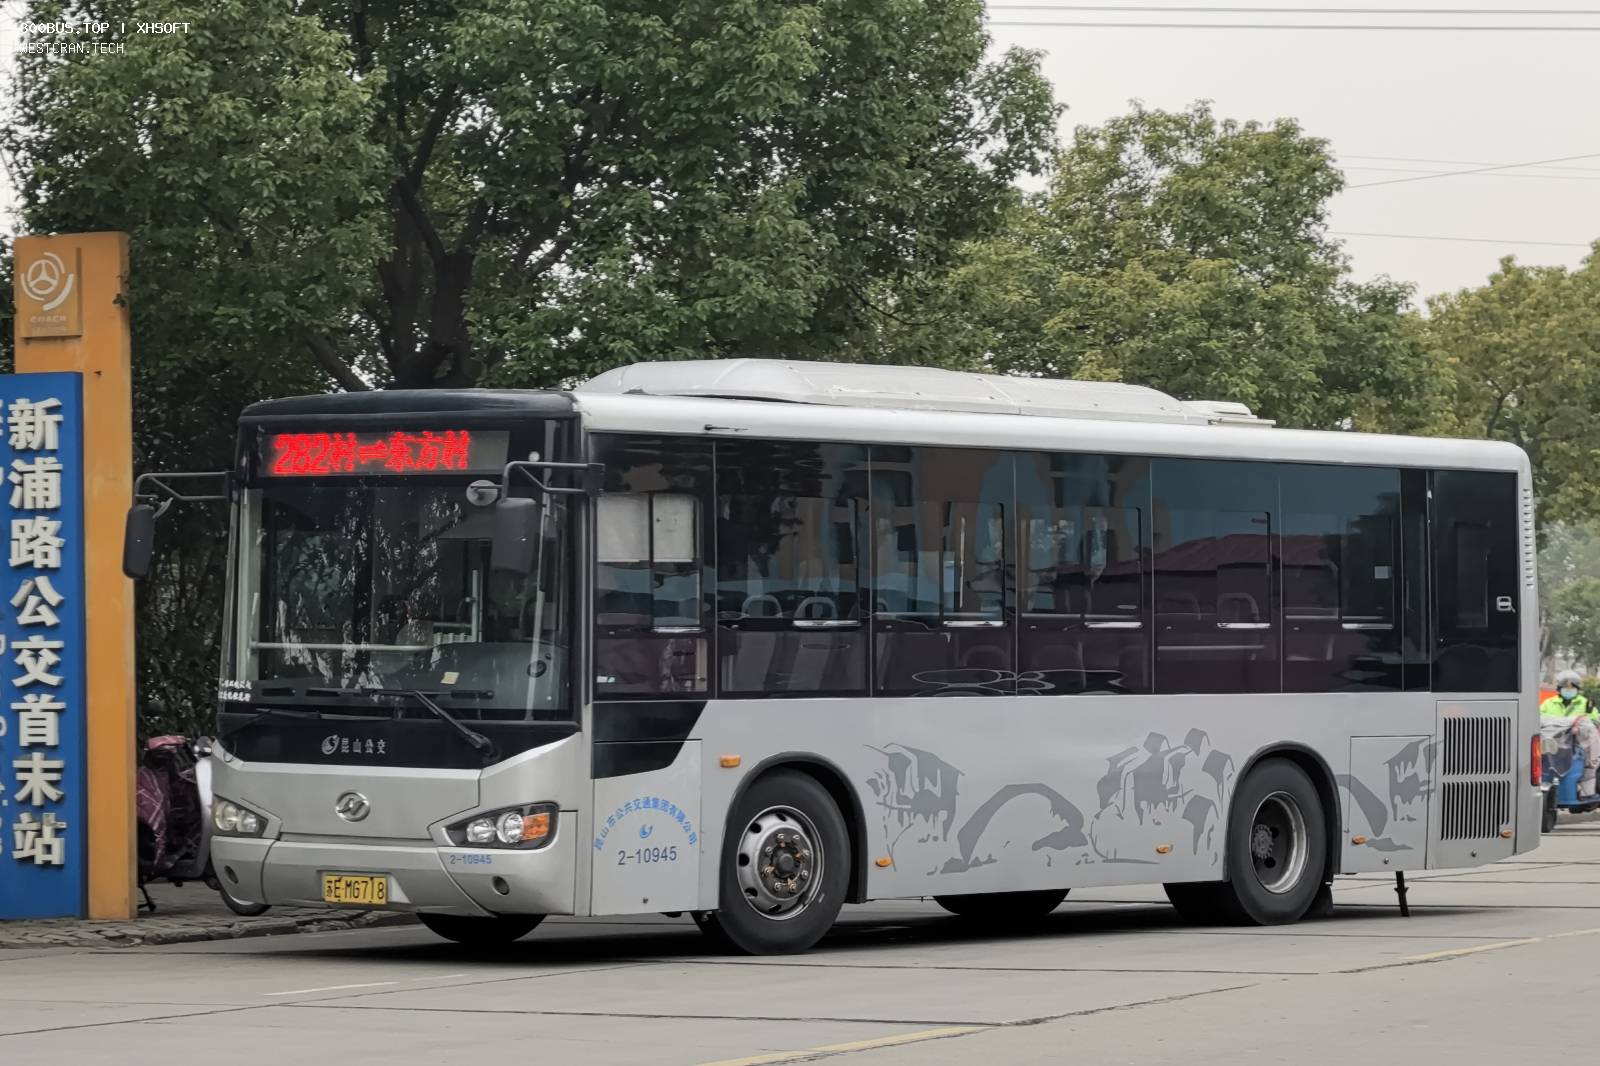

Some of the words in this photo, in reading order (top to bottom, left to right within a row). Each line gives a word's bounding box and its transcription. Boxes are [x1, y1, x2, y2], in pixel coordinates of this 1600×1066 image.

[7, 397, 67, 866] 新浦路公交首末站
[341, 737, 386, 755] 昆山公交
[450, 854, 493, 865] 2-10945
[618, 846, 678, 866] 2-10945
